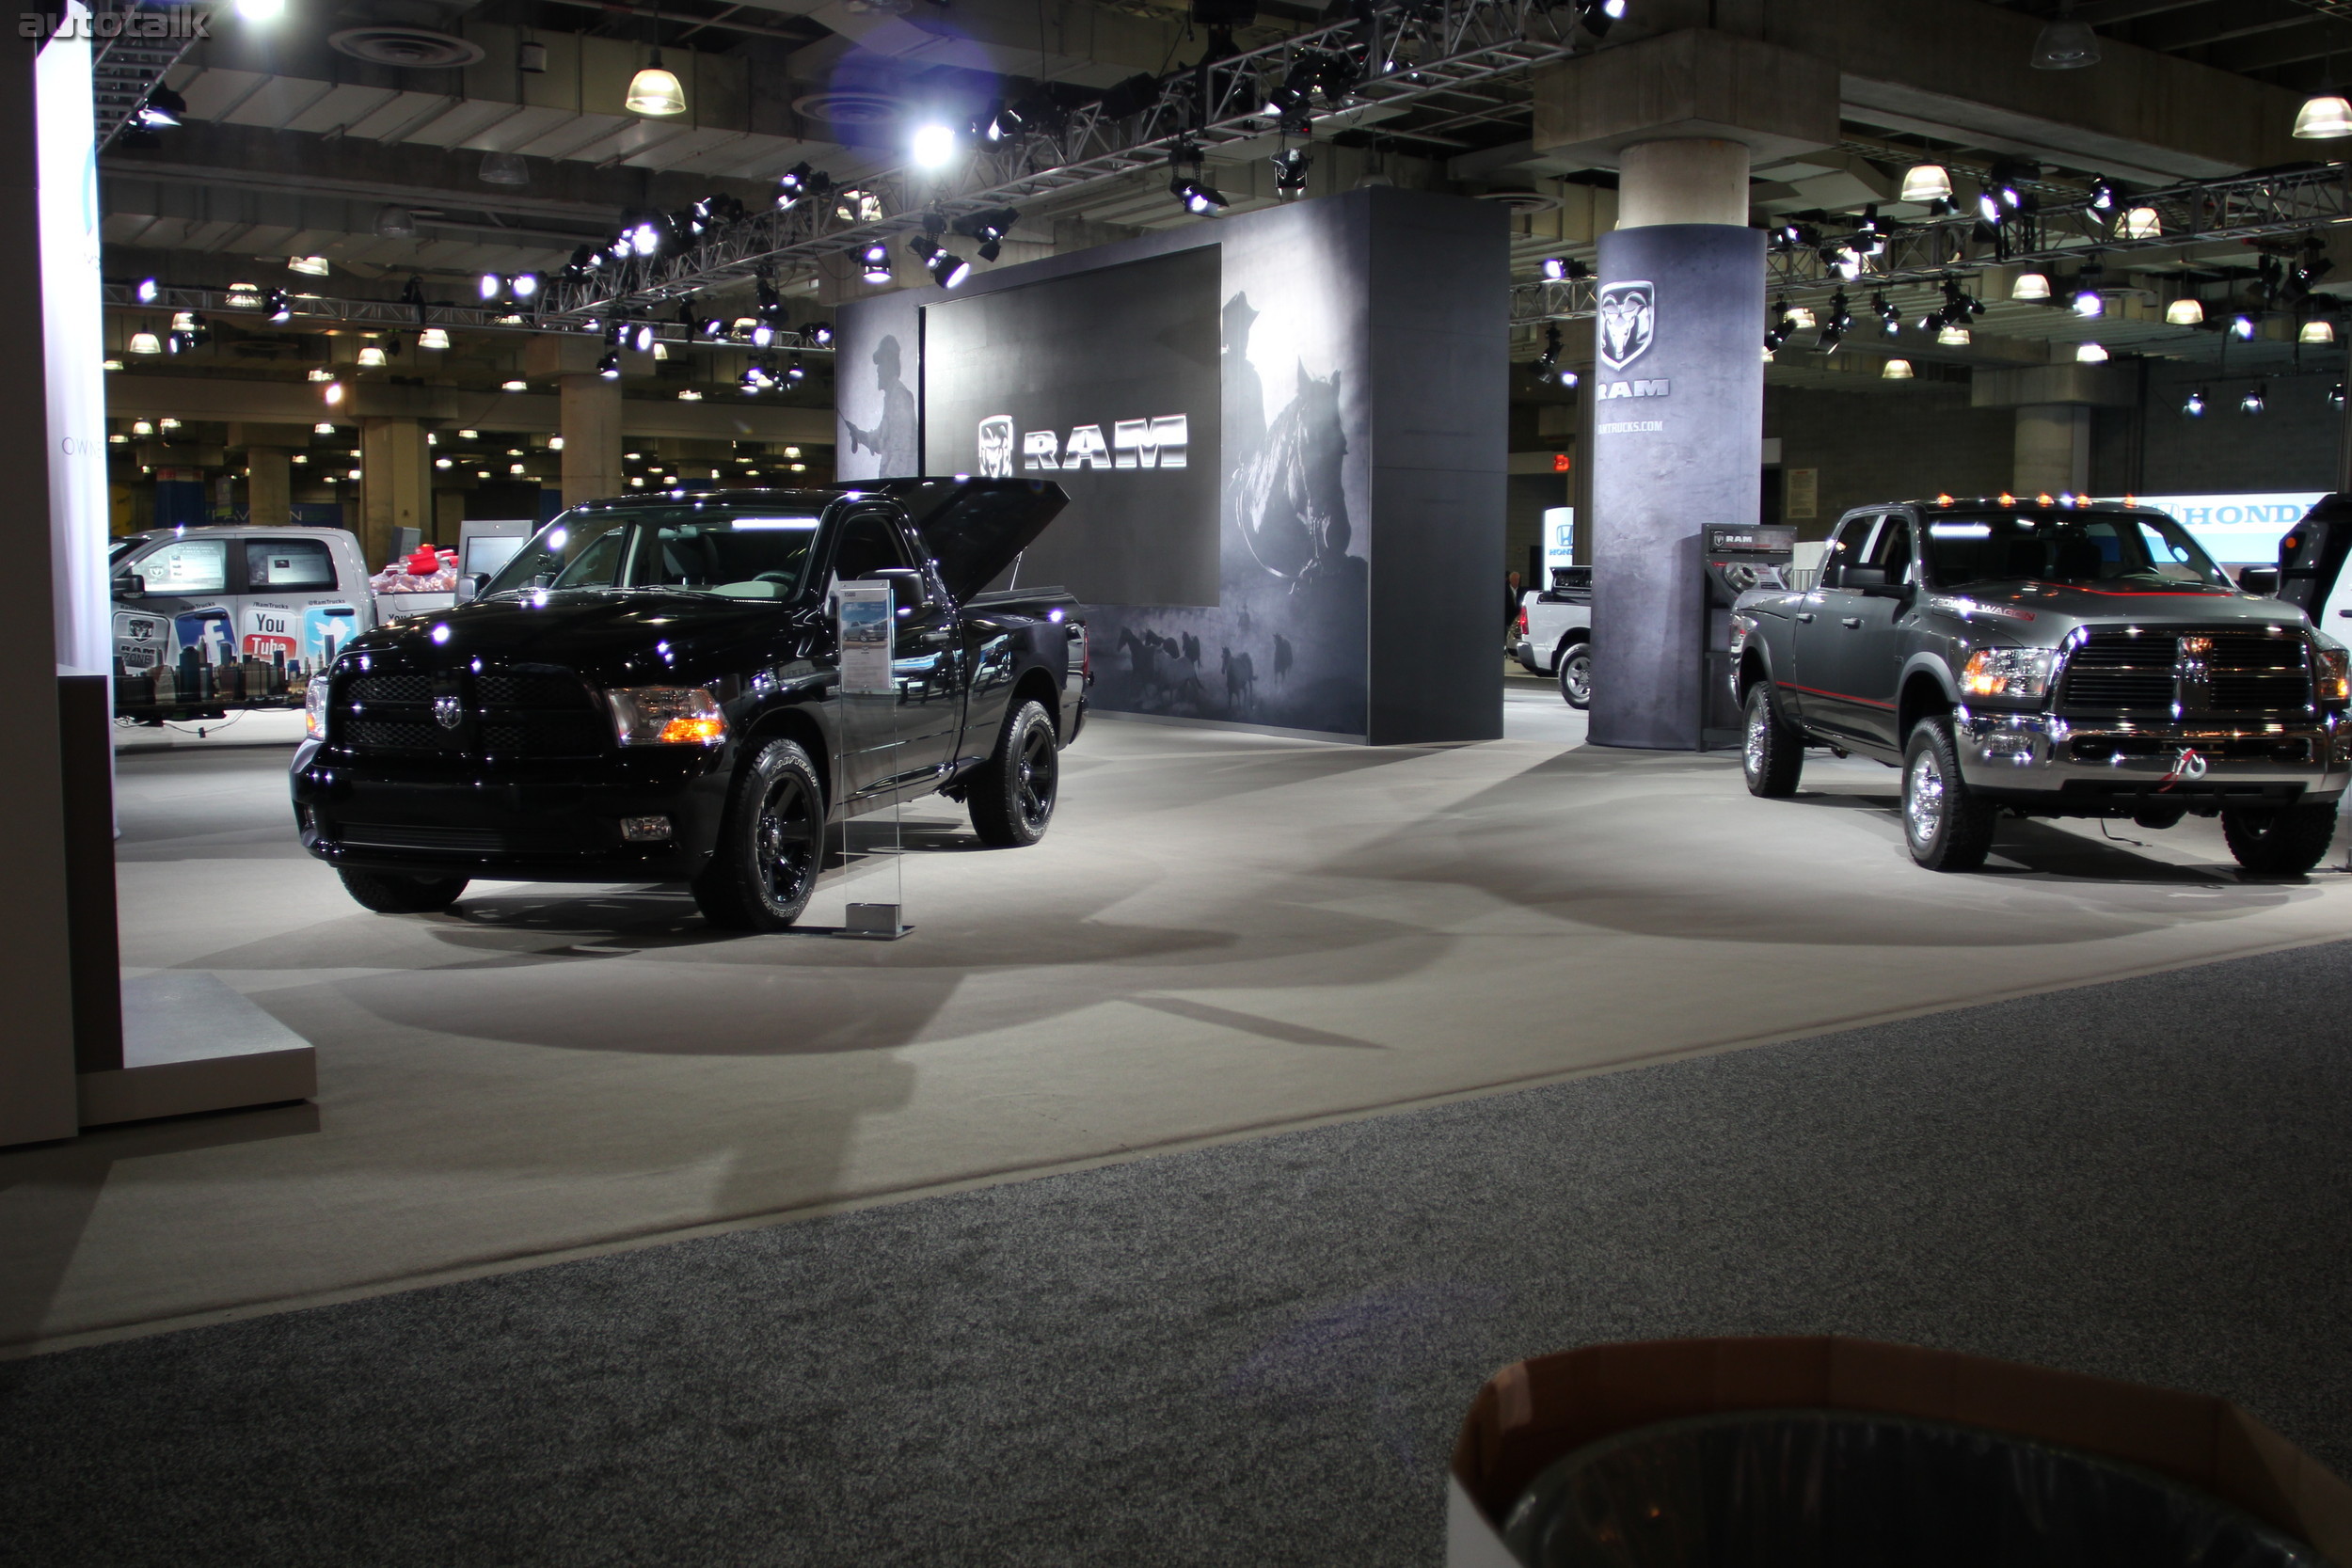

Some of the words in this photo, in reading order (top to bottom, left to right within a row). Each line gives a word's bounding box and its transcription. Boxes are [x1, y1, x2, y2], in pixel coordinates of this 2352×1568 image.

[1597, 379, 1669, 402] RAM
[1024, 413, 1187, 469] RAM
[2183, 503, 2316, 525] HOND
[256, 612, 285, 633] You
[1981, 604, 2037, 622] WAGON
[120, 645, 156, 655] RAM
[123, 652, 151, 664] ZONE
